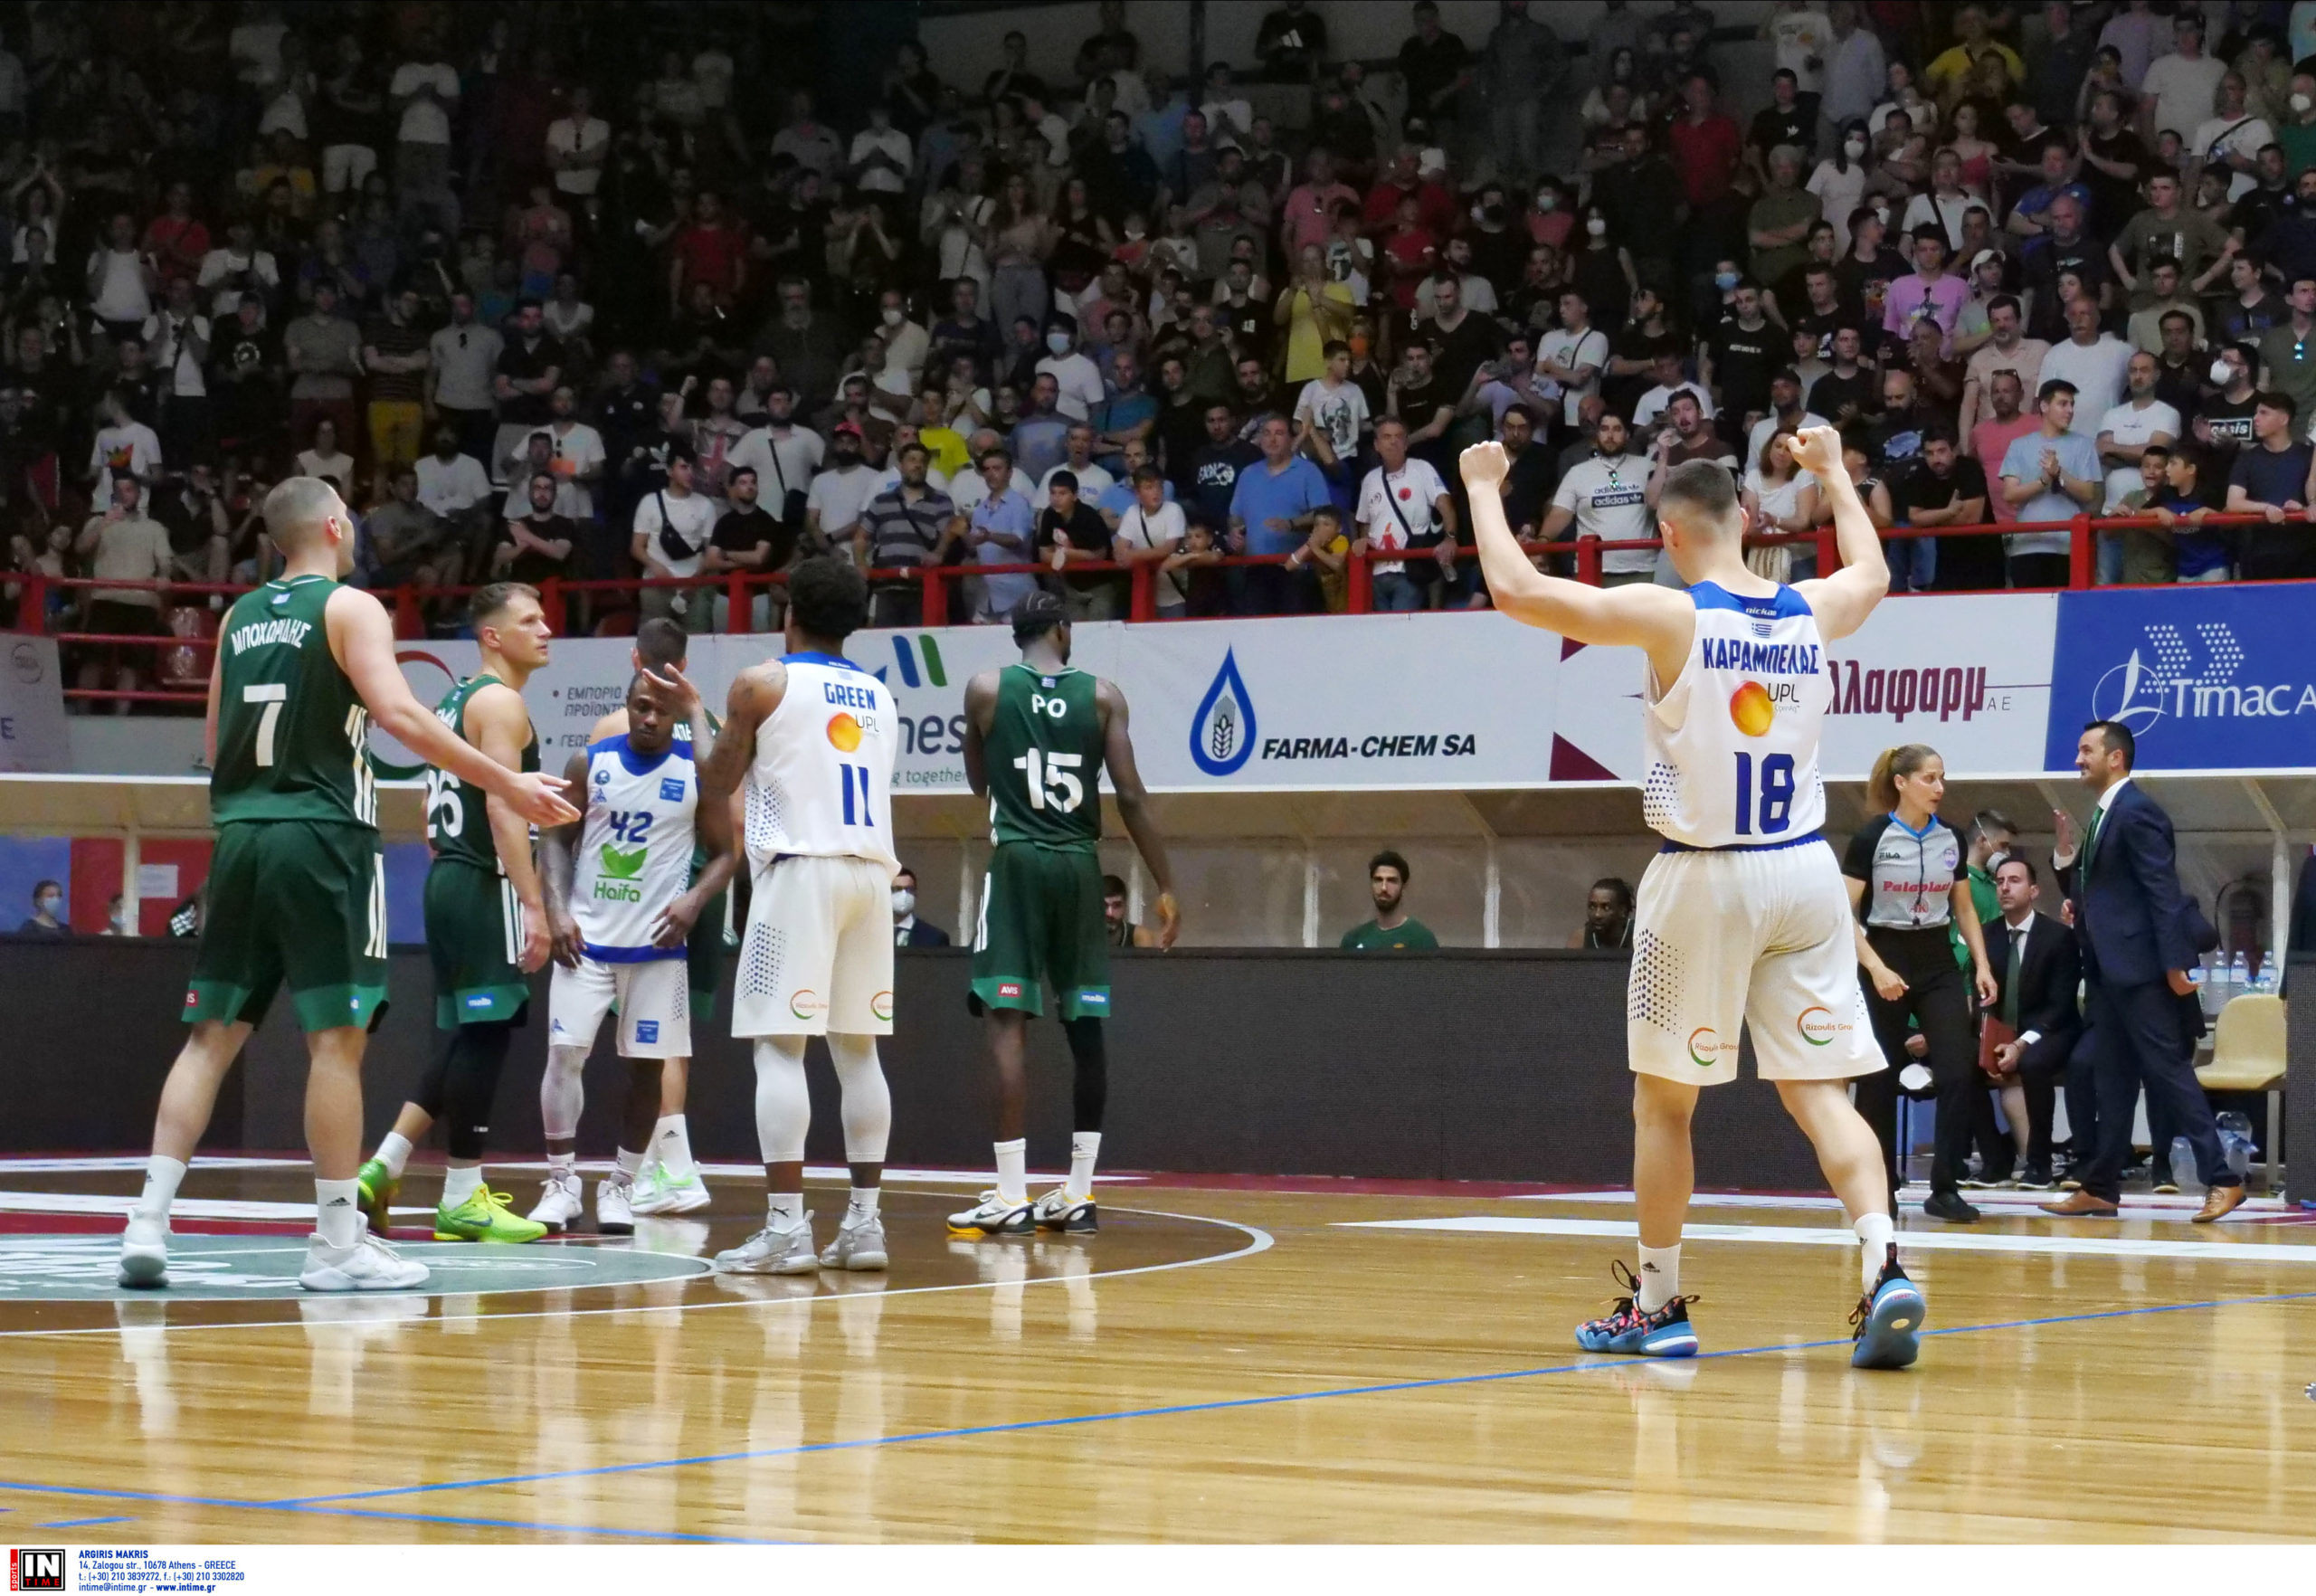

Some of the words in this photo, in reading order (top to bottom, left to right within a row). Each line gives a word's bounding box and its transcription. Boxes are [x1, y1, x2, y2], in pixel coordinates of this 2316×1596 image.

[1594, 496, 1629, 507] adidas
[1702, 637, 1819, 675] ΚΑΡΑΜΠΕΛΑΣ
[567, 686, 622, 700] ΕΜΠΟΡΙΟ
[823, 682, 877, 710] GREEN
[1031, 694, 1067, 718] PO
[1767, 682, 1800, 703] UPL
[2169, 679, 2292, 717] Timac
[243, 683, 287, 766] 7
[855, 714, 879, 733] UPL
[1261, 734, 1438, 760] FARMA-CHEM
[1441, 734, 1476, 757] SA
[1013, 747, 1084, 813] 15
[1734, 752, 1796, 835] 18
[427, 768, 464, 839] 26
[840, 764, 875, 827] 11
[610, 811, 654, 843] 42
[593, 880, 641, 903] Haifa
[1001, 986, 1019, 995] AVIS
[1805, 1022, 1837, 1031] Rizoulis
